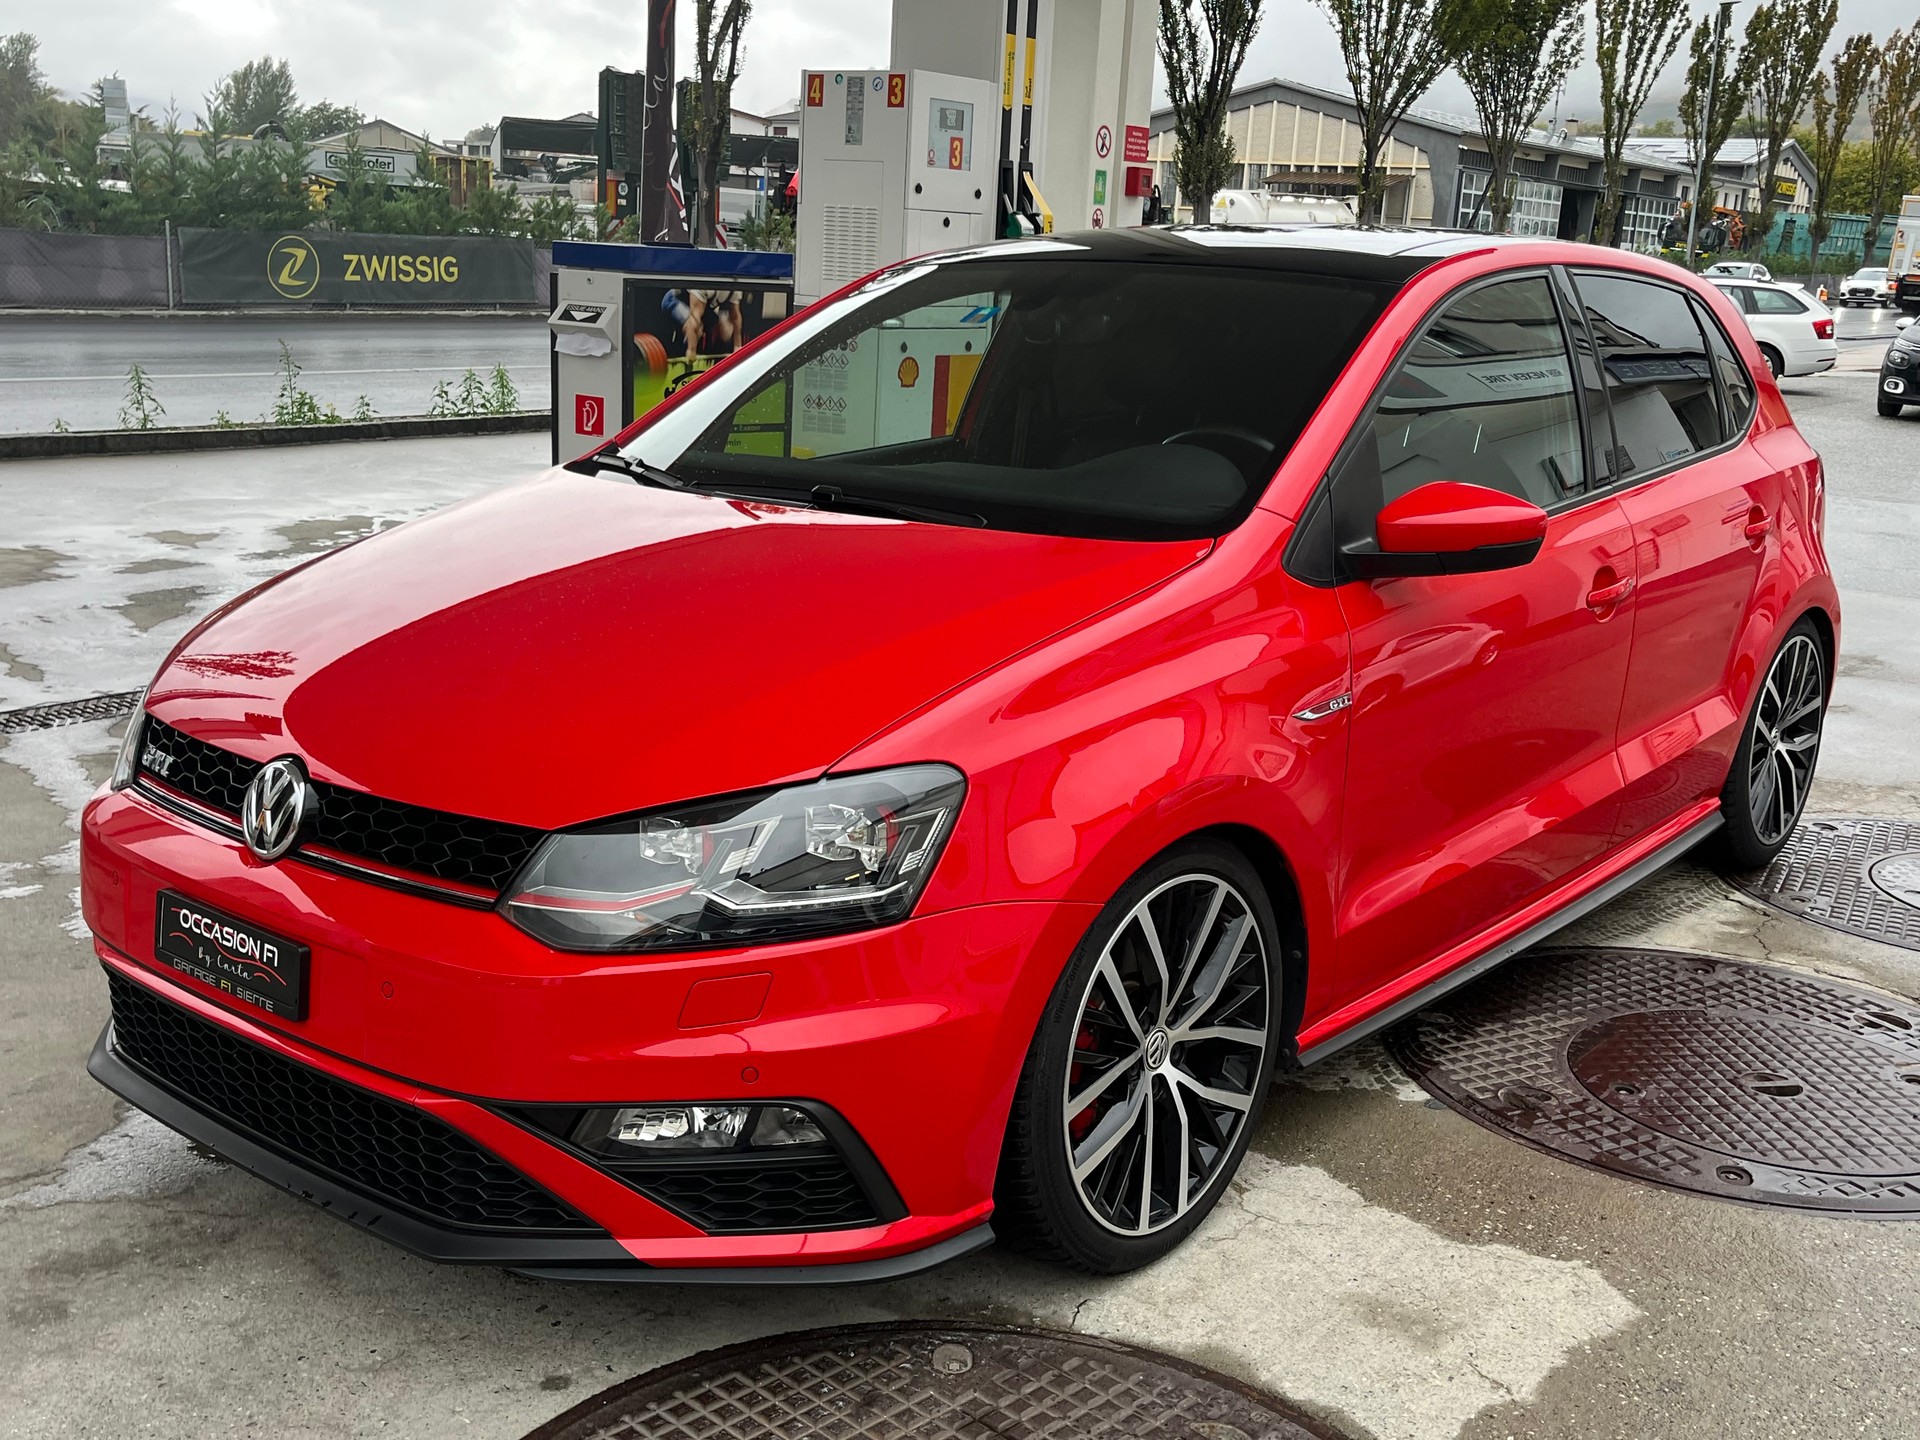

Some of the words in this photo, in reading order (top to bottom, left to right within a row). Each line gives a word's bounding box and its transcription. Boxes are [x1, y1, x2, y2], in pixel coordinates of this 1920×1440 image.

[810, 77, 821, 104] 4
[890, 77, 902, 105] 3
[951, 140, 961, 167] 3
[343, 254, 459, 283] ZWISSIG
[1329, 695, 1349, 710] GTI
[180, 909, 261, 959] OCCASION
[173, 958, 217, 987] GARAGE
[220, 979, 232, 994] F1
[236, 986, 274, 1013] SIERRE
